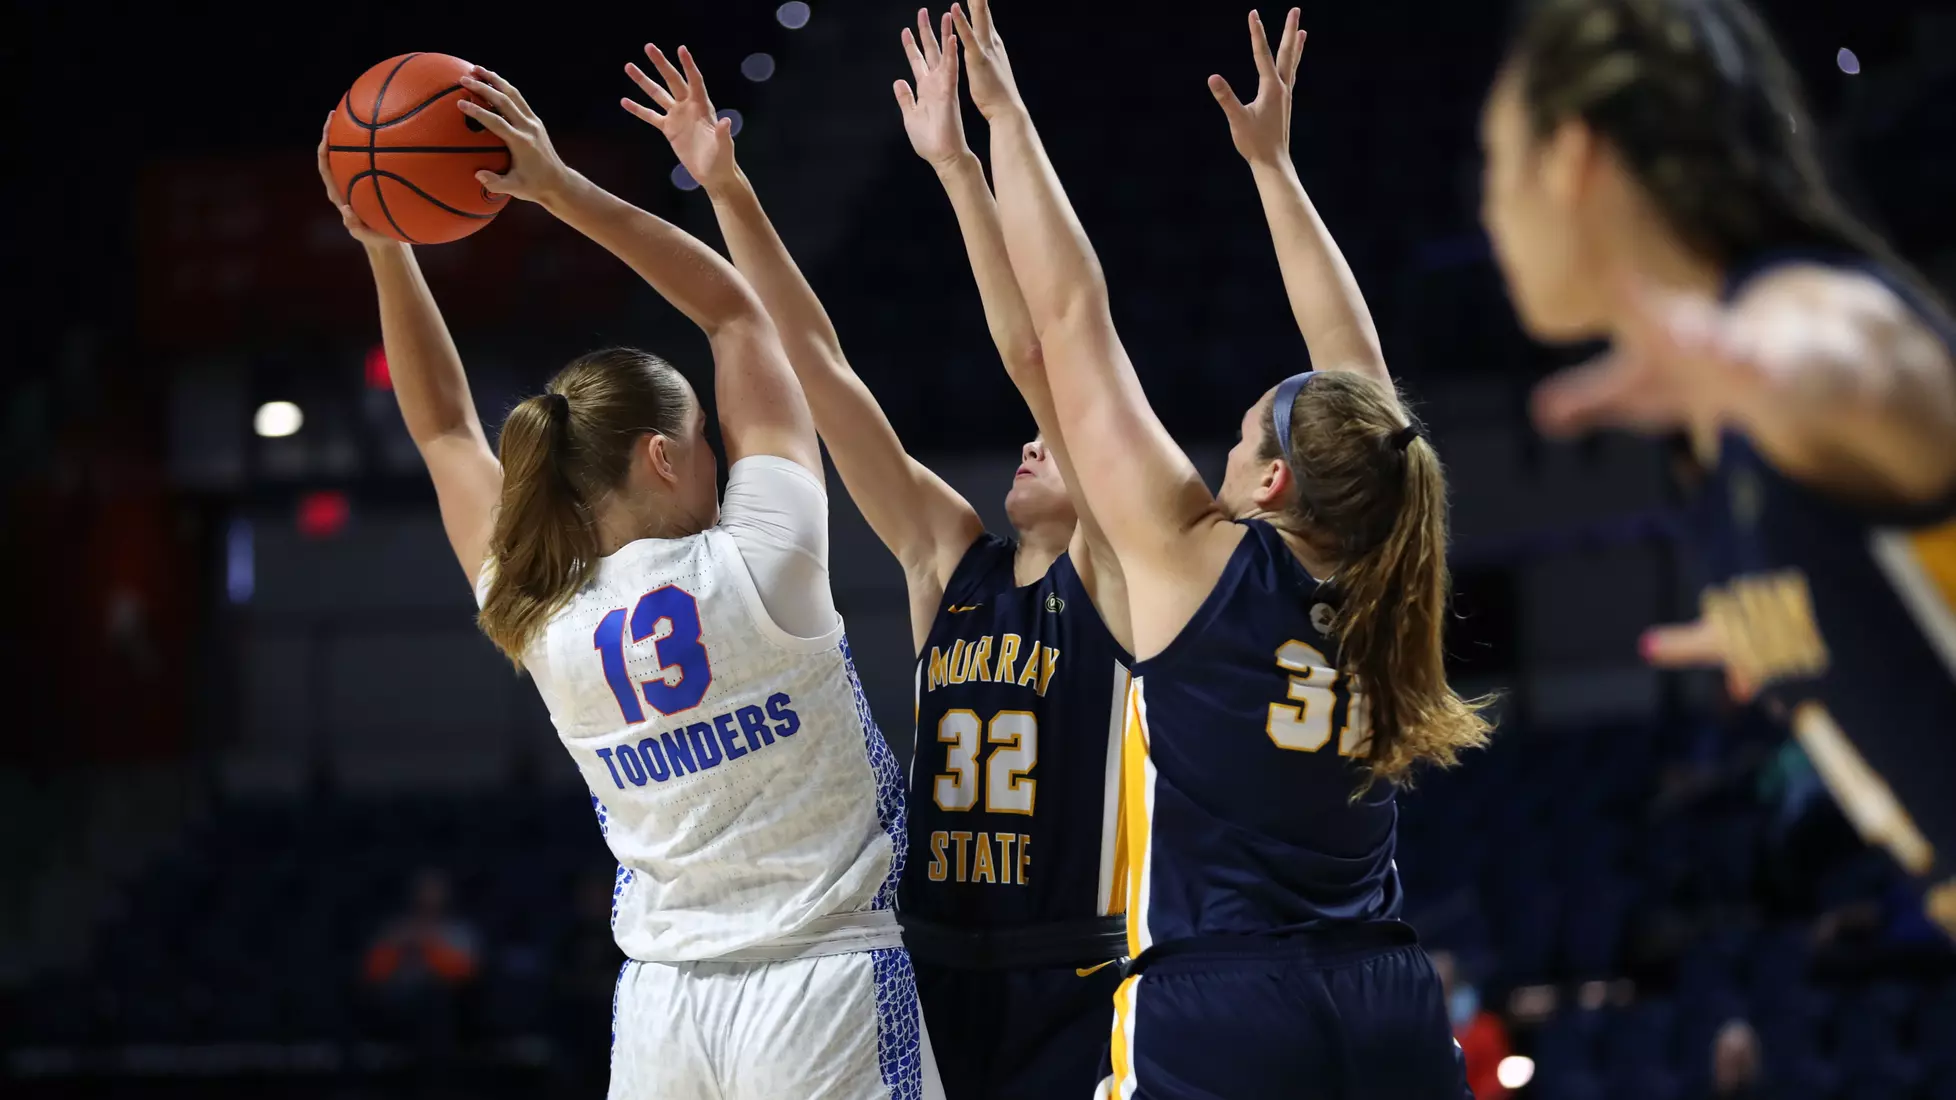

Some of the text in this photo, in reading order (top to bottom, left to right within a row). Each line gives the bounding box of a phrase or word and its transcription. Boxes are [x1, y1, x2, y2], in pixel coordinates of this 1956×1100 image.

[594, 584, 712, 724] 13
[928, 633, 1060, 697] MURRAY
[596, 692, 800, 789] TOONDERS
[933, 708, 1038, 816] 32
[928, 831, 1030, 885] STATE
